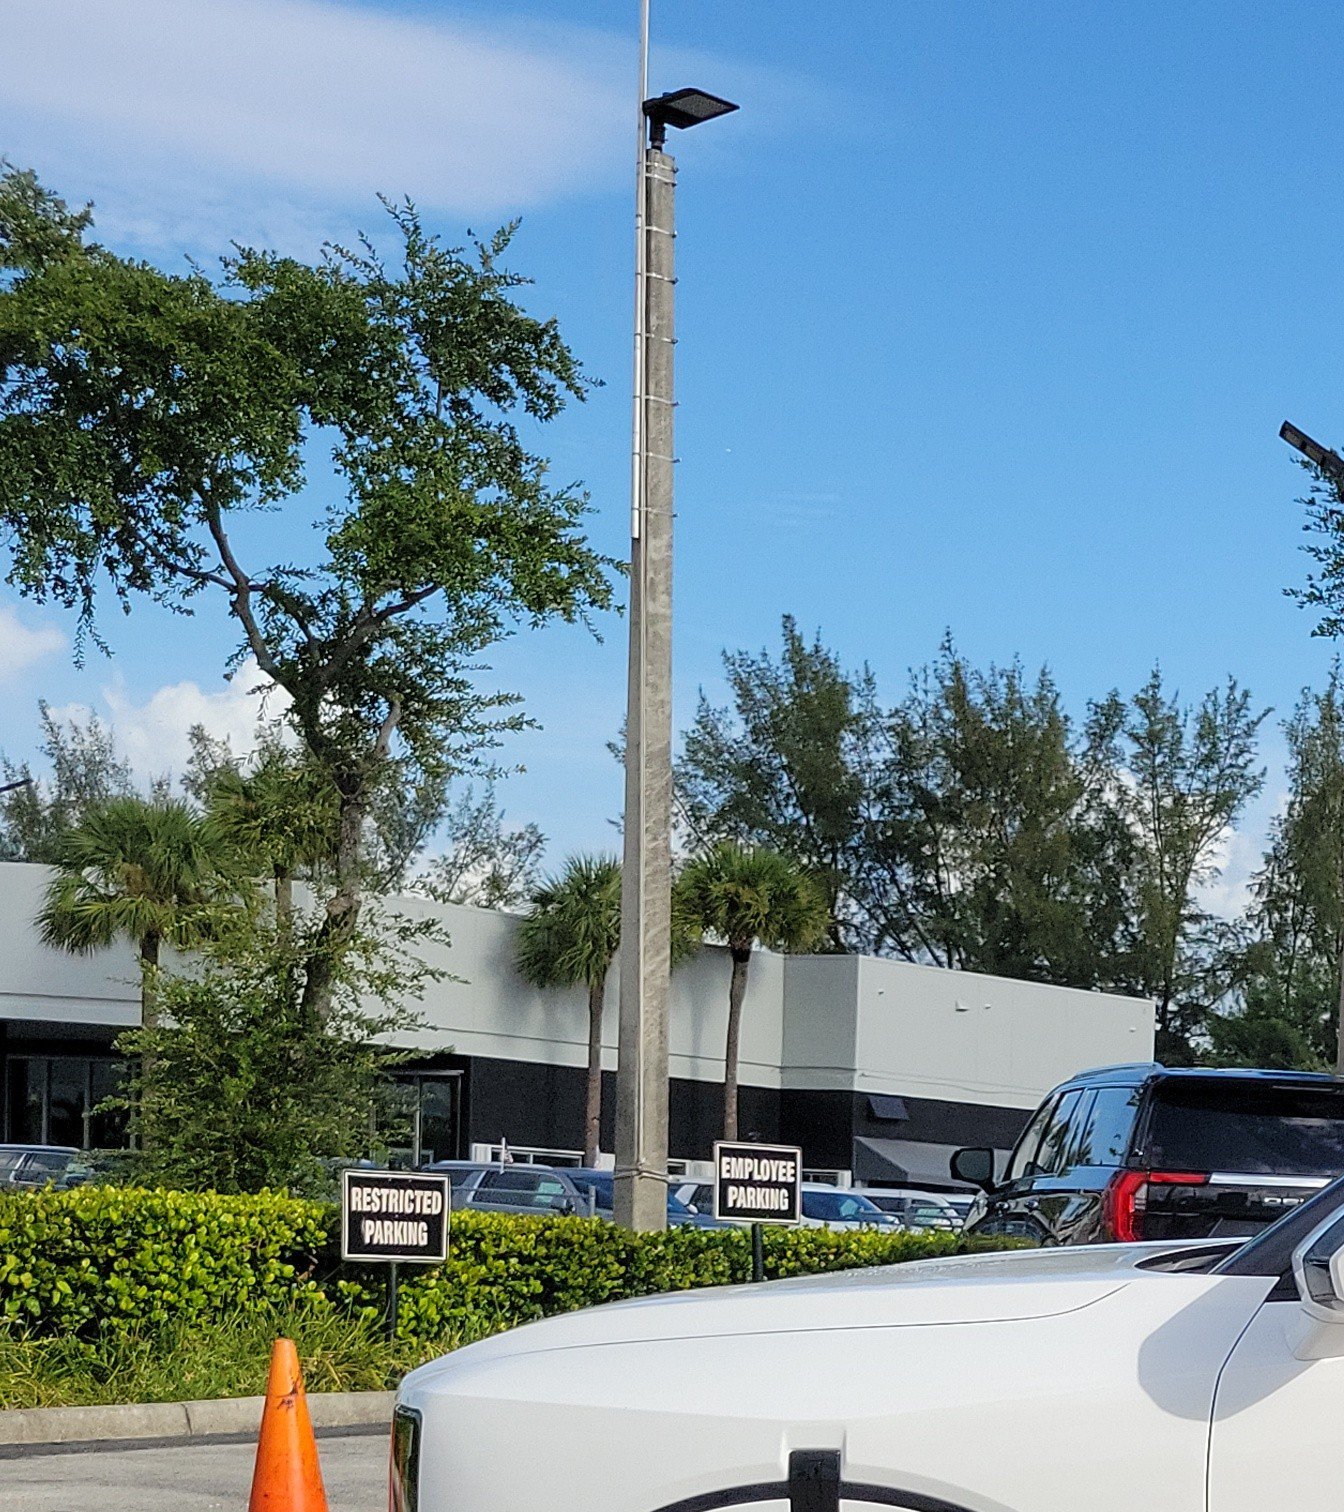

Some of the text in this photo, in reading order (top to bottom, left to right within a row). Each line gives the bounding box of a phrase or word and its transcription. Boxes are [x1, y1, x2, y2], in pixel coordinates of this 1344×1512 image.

[721, 1155, 796, 1183] EMPLOYEE
[351, 1186, 442, 1215] RESTRICTED
[727, 1185, 789, 1211] PARKING
[364, 1219, 429, 1247] PARKING
